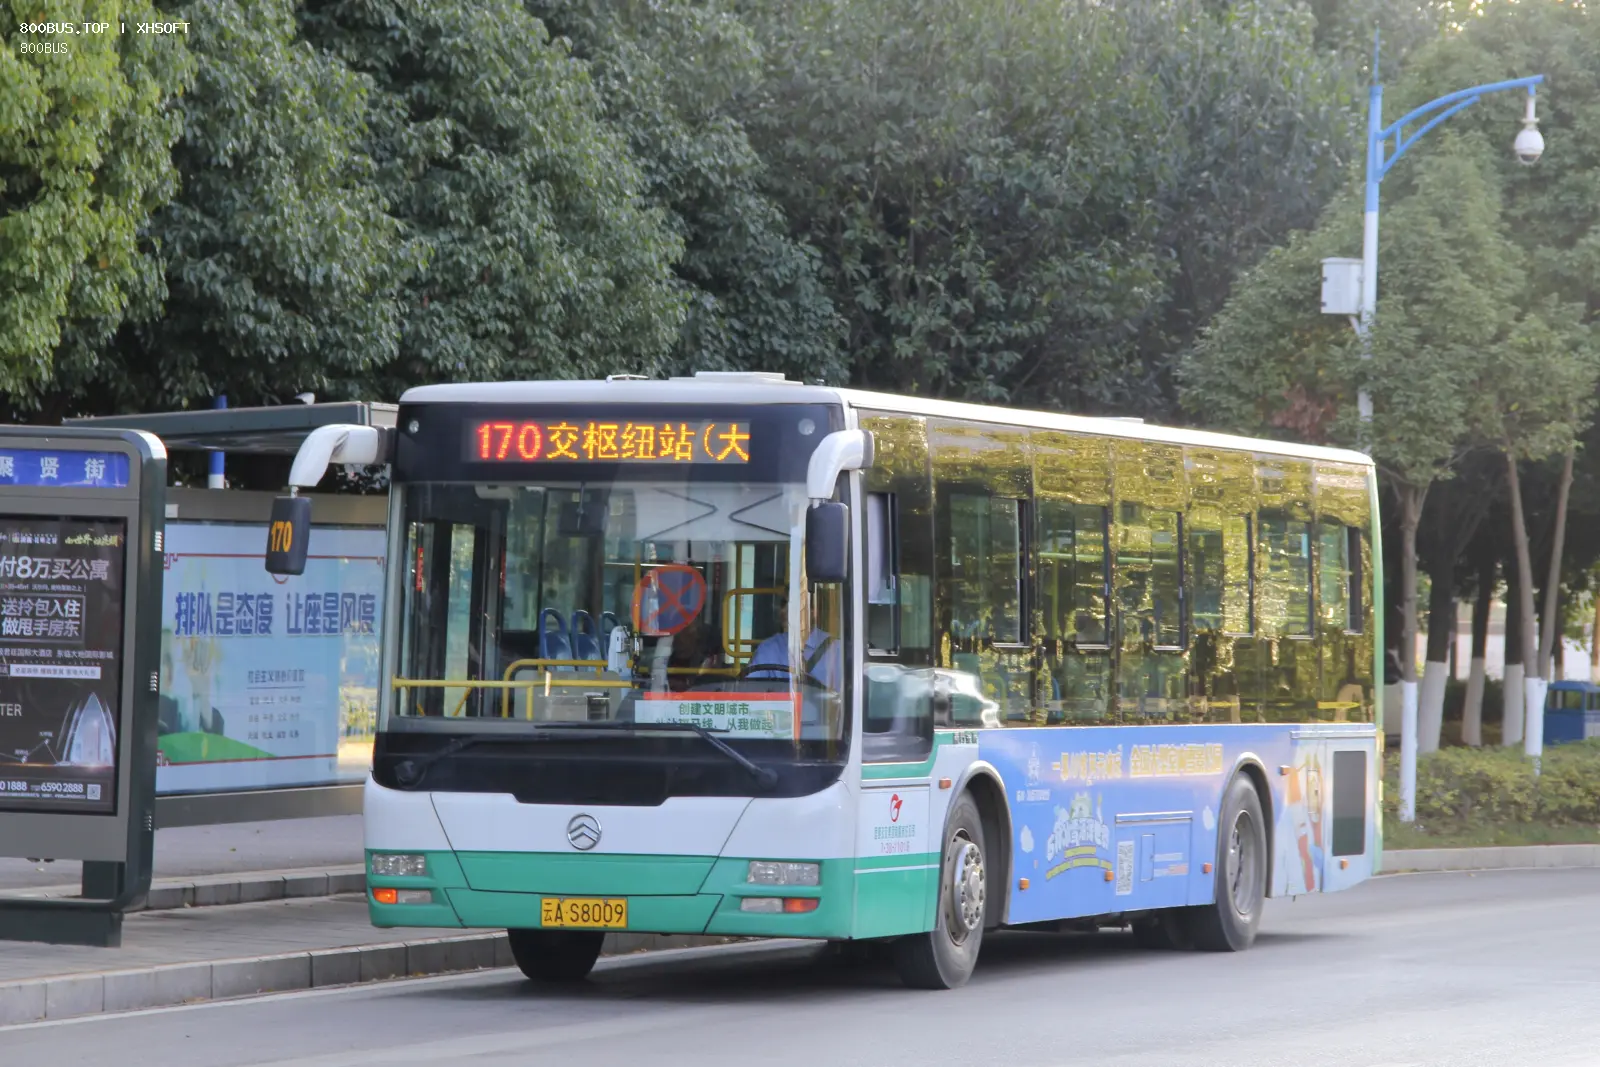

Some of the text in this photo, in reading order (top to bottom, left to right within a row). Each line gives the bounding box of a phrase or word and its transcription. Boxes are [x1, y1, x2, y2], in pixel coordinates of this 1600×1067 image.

[477, 421, 542, 459] 170
[271, 521, 293, 552] 170
[0, 556, 109, 580] 付8万买公寓
[1, 597, 81, 618] 送拎包入住
[175, 592, 375, 635] 排队是态度 让座是风度
[2, 618, 80, 637] 做甩手房东
[679, 702, 749, 716] 创建文明城市
